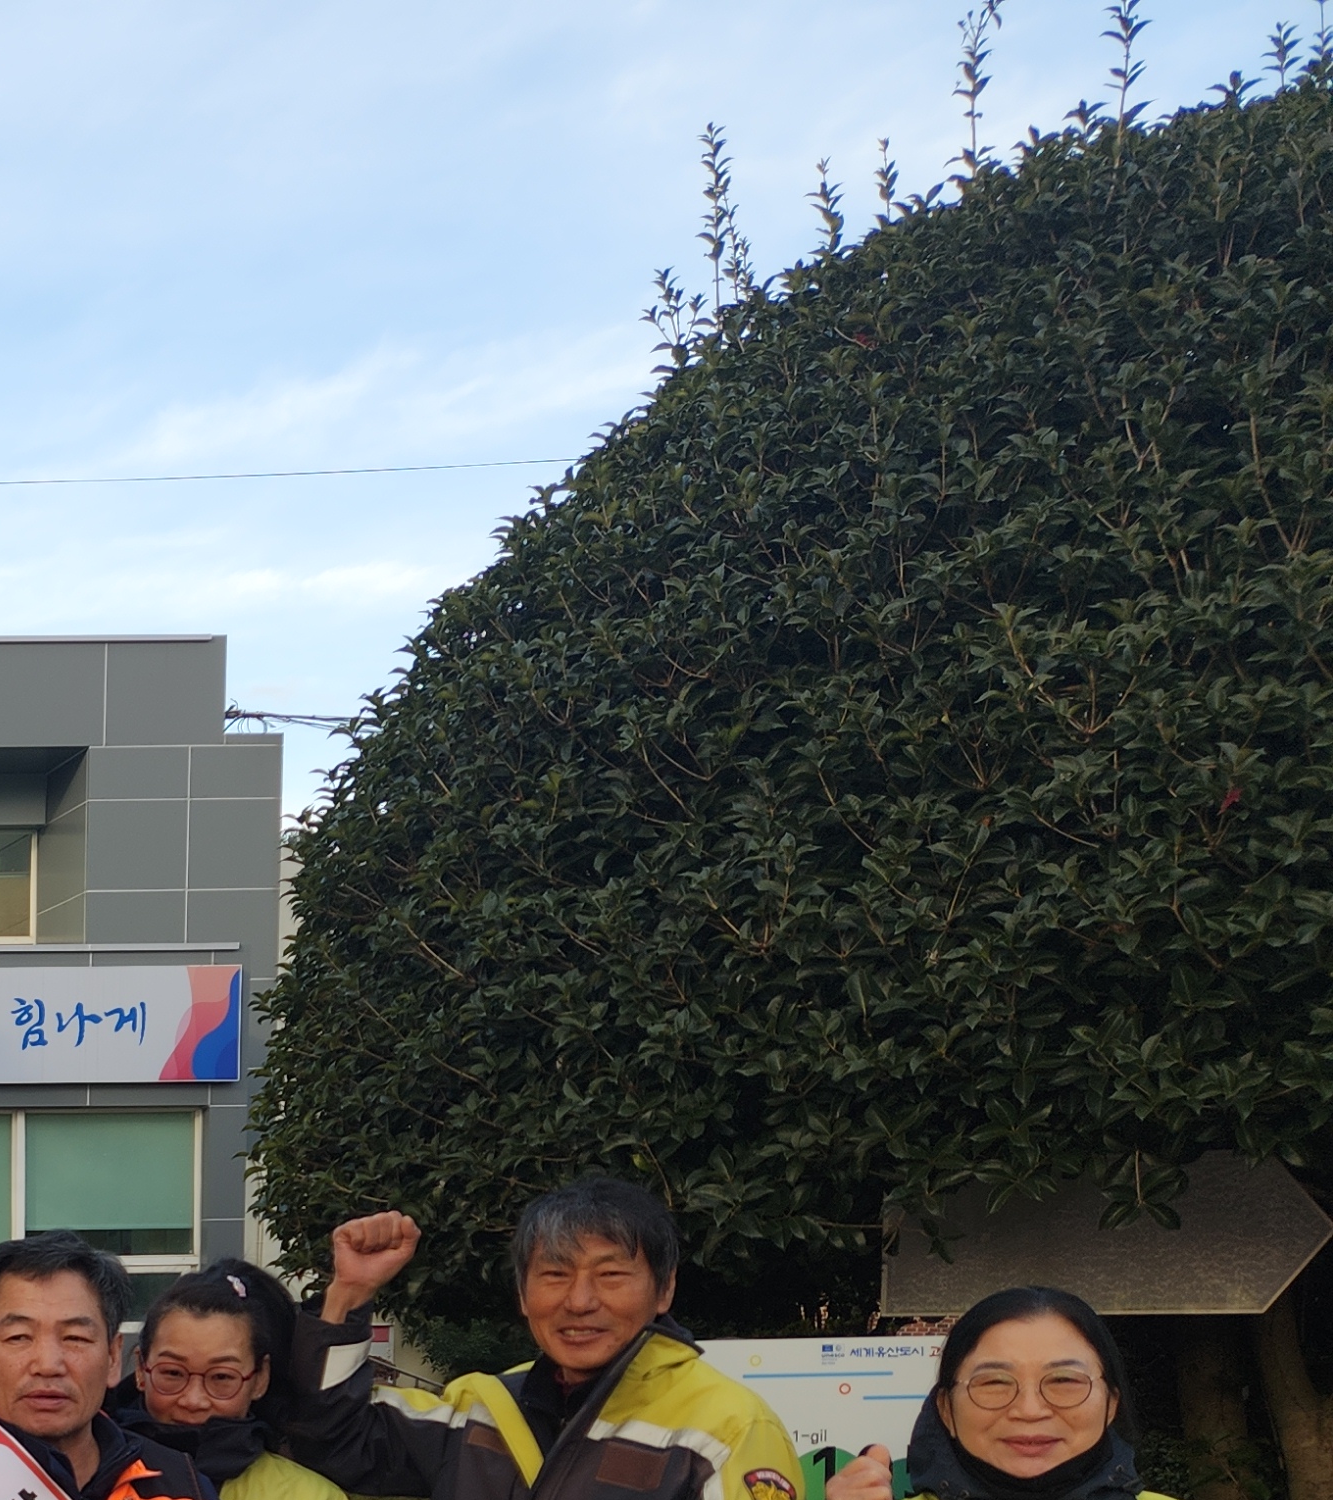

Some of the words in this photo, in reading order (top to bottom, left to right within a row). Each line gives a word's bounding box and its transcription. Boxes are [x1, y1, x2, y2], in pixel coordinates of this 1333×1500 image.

[10, 997, 147, 1050] 힘나게
[850, 1346, 924, 1358] 세계유산도시
[793, 1429, 827, 1444] 1-gil
